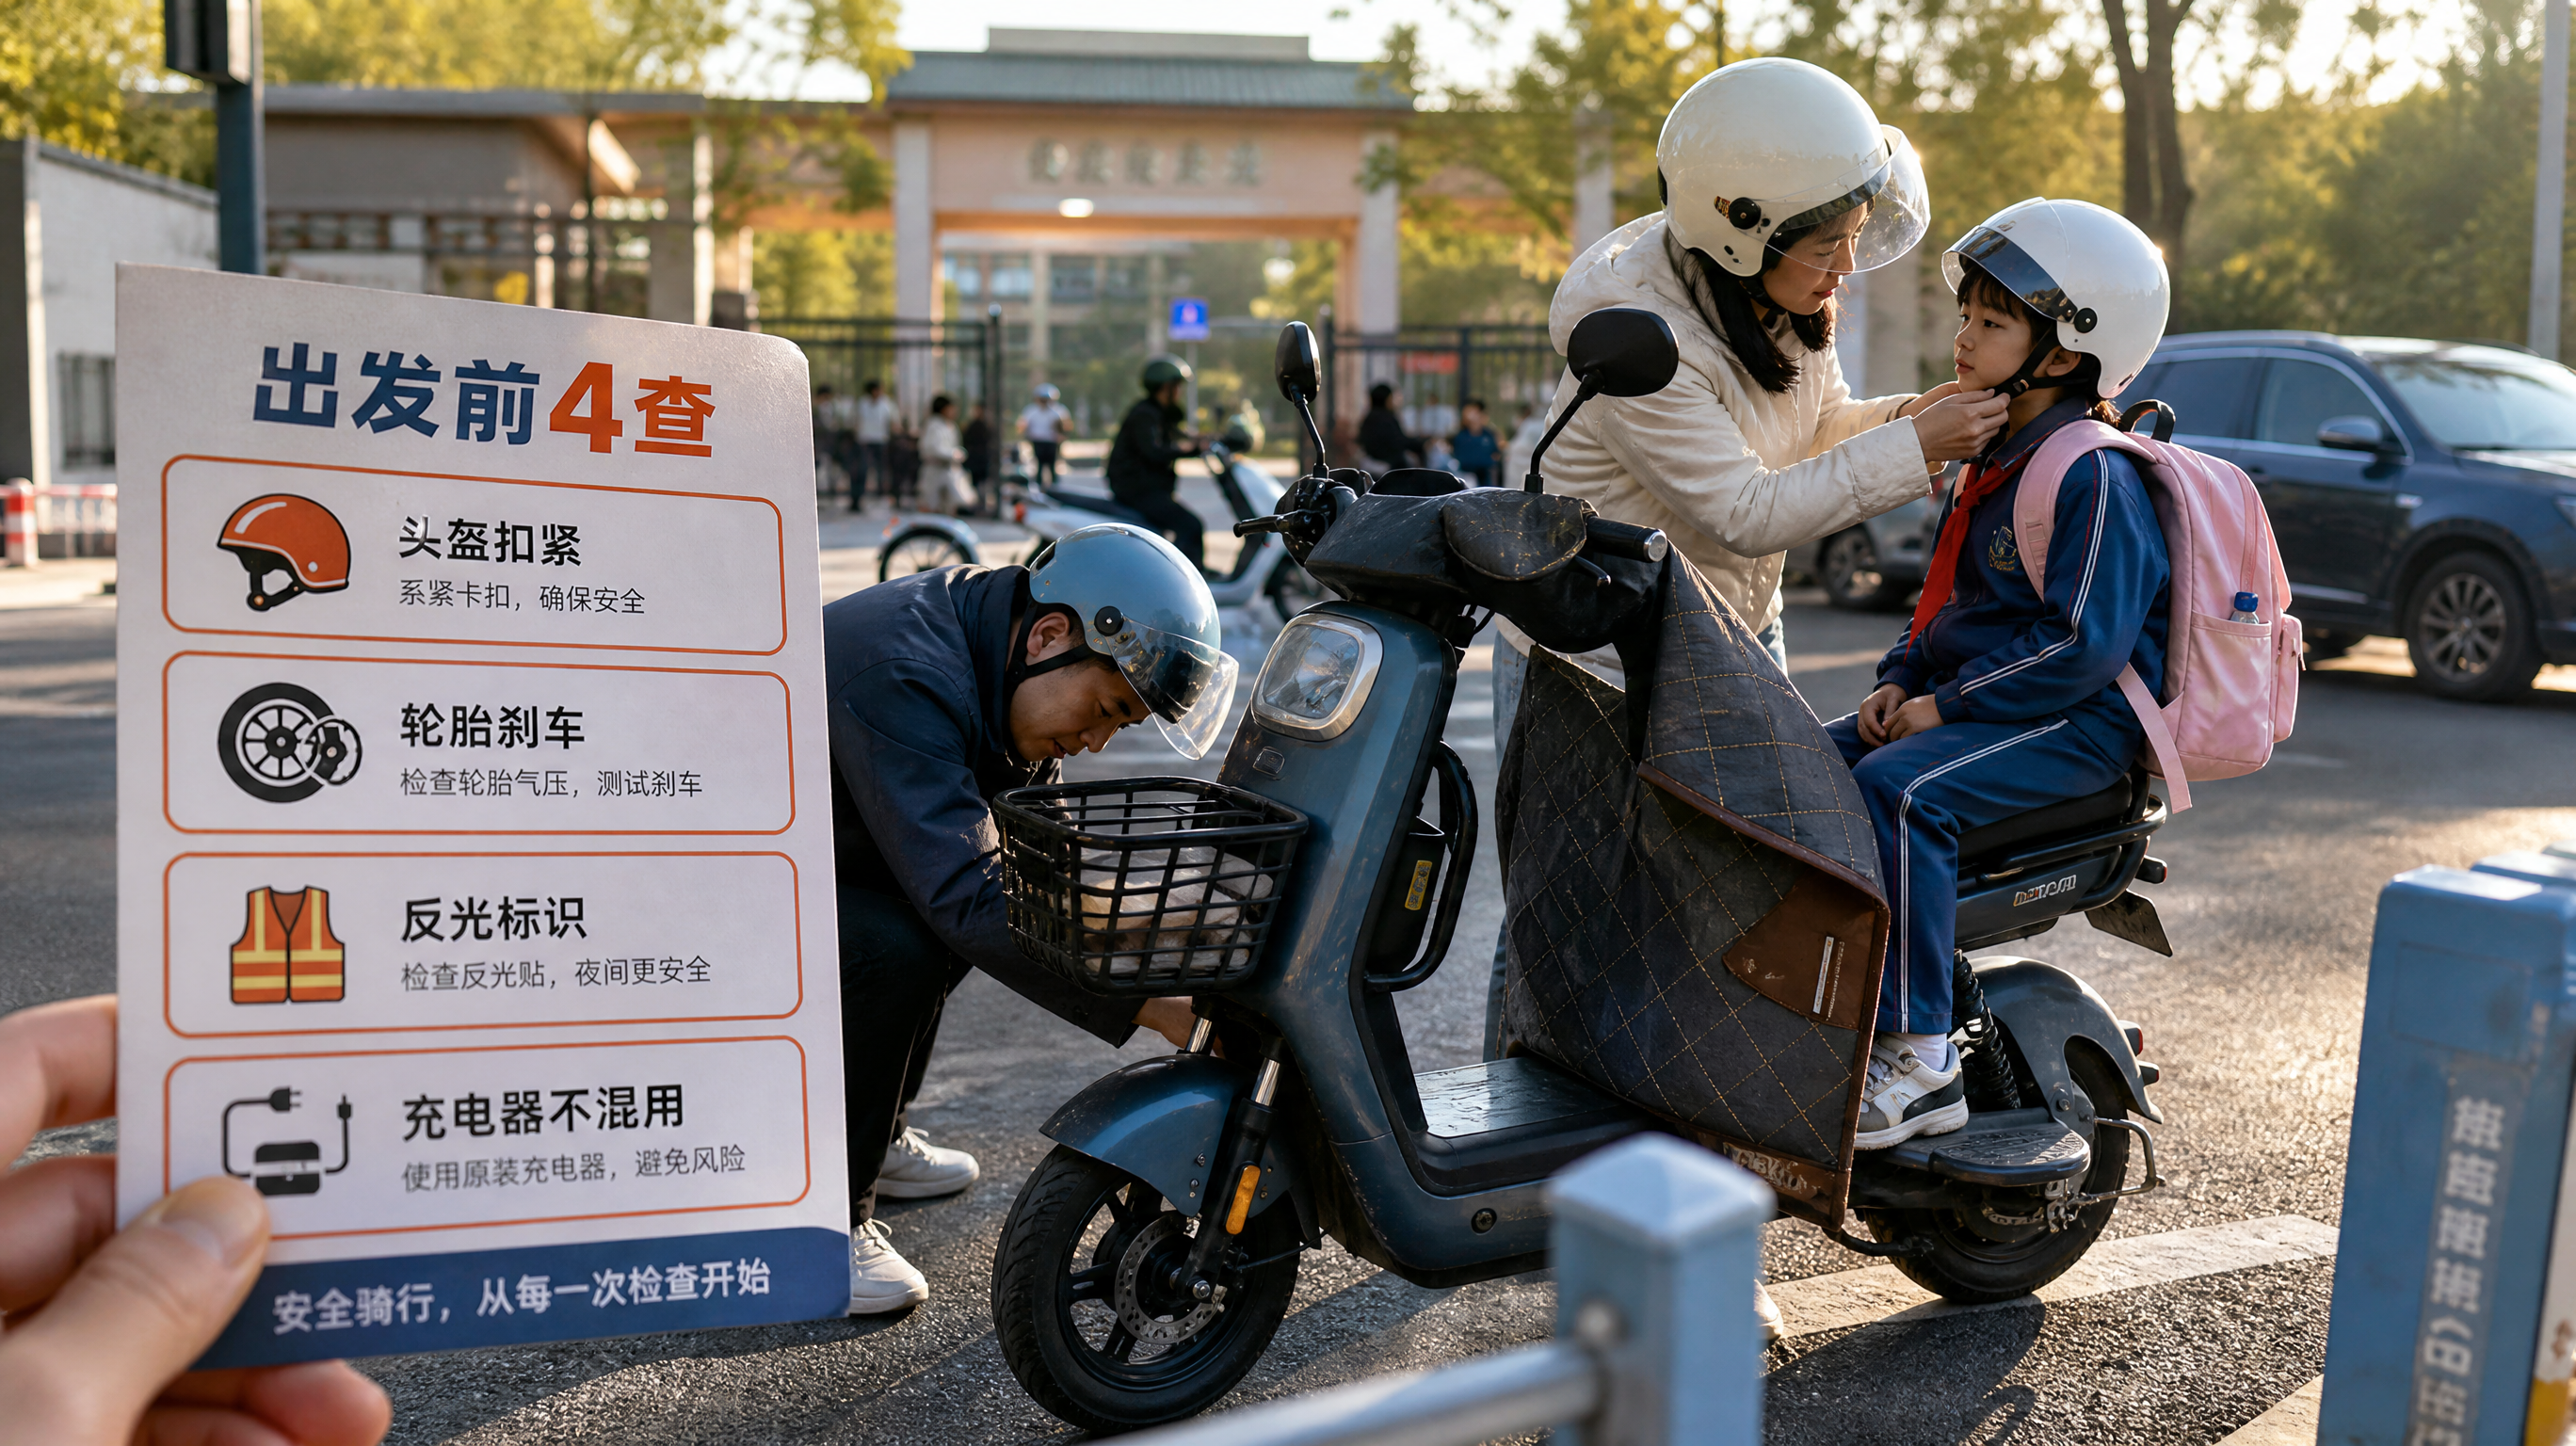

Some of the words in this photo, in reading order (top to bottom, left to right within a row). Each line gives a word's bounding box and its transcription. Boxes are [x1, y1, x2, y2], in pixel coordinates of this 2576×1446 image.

[252, 342, 716, 458] 出发前4查
[398, 515, 582, 567] 头盔扣紧
[399, 579, 646, 615] 系紧卡扣，确保安全
[399, 702, 586, 750] 轮胎刹车
[399, 768, 703, 798] 检查轮胎气压，测试刹车
[401, 896, 588, 942] 反光标识
[401, 956, 712, 992] 检查反光贴，夜间更安全
[403, 1084, 684, 1140] 充电器不混用
[401, 1143, 747, 1193] 使用原装充电器，避免风险
[272, 1258, 771, 1335] 安全骑行，从每一次检查开始
